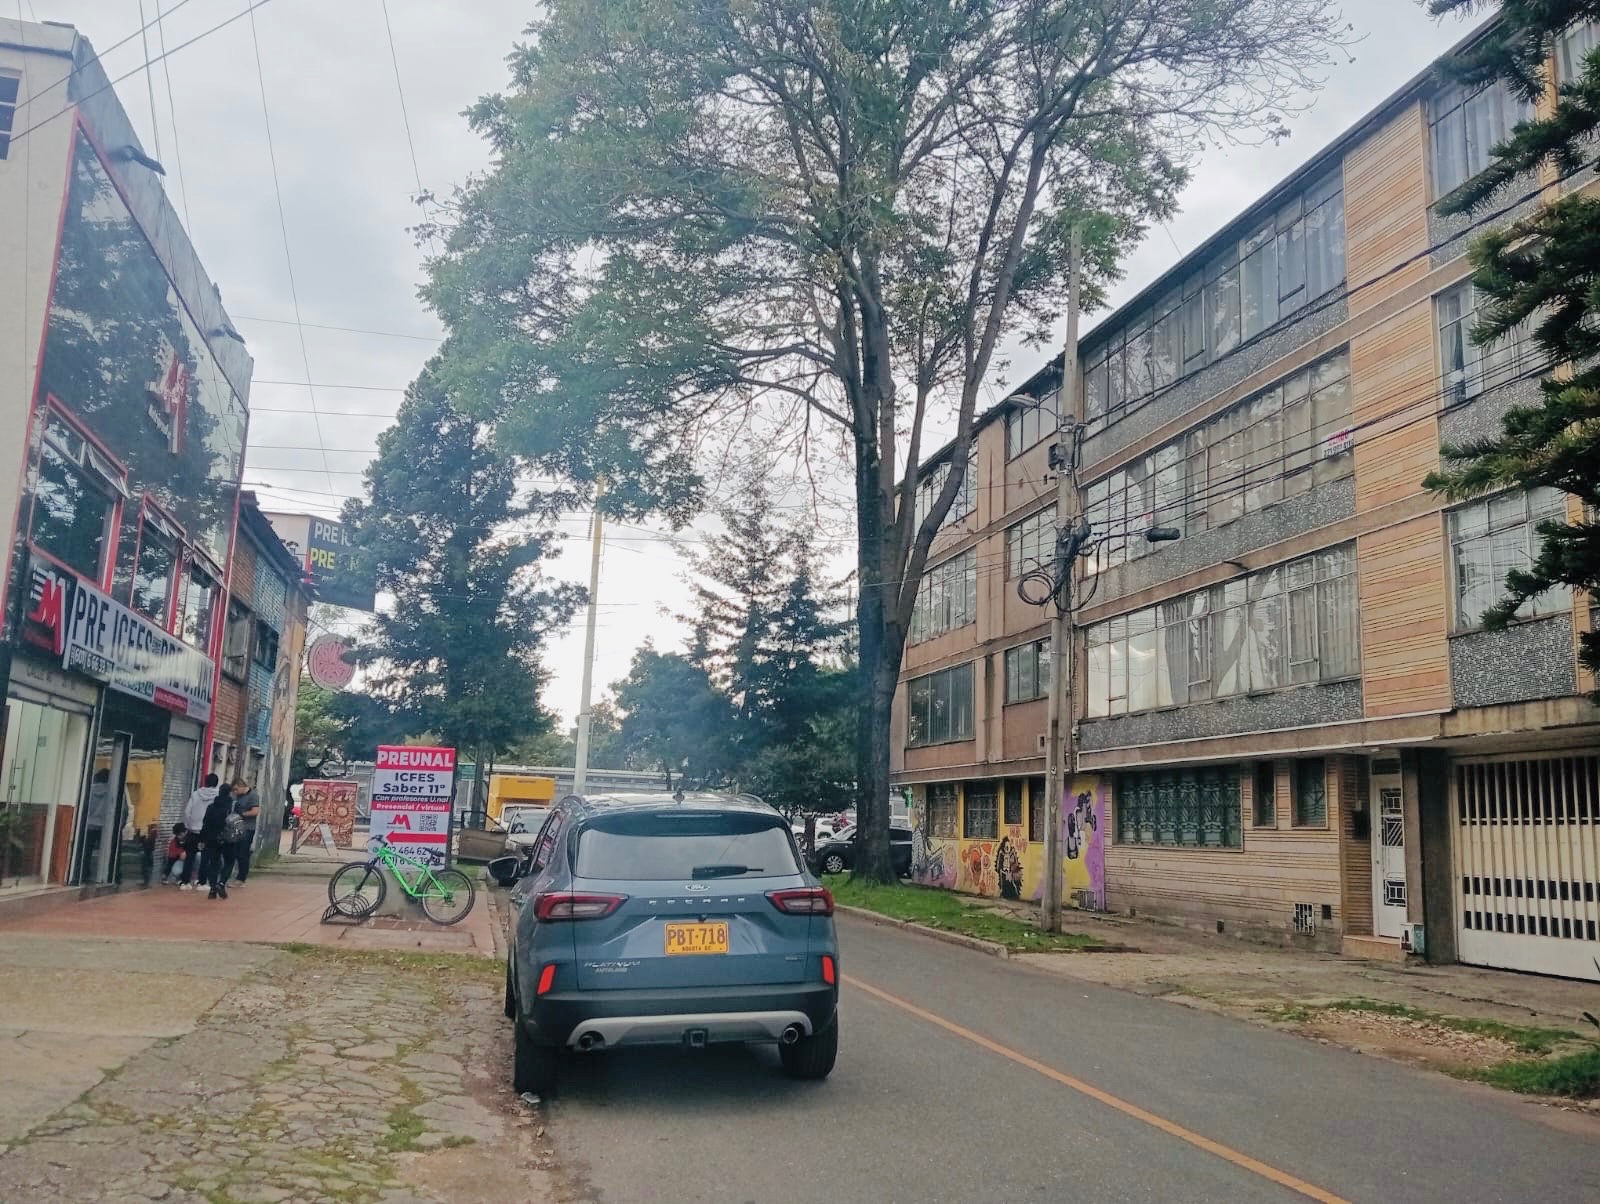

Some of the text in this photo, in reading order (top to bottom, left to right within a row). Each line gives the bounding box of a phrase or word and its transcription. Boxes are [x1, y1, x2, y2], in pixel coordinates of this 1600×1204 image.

[314, 521, 338, 543] PRE
[310, 547, 336, 570] PRE
[72, 586, 109, 653] PRE
[377, 750, 454, 768] PREUNAL
[395, 772, 435, 782] ICFES
[383, 783, 425, 793] Saber
[376, 803, 415, 811] Presencial
